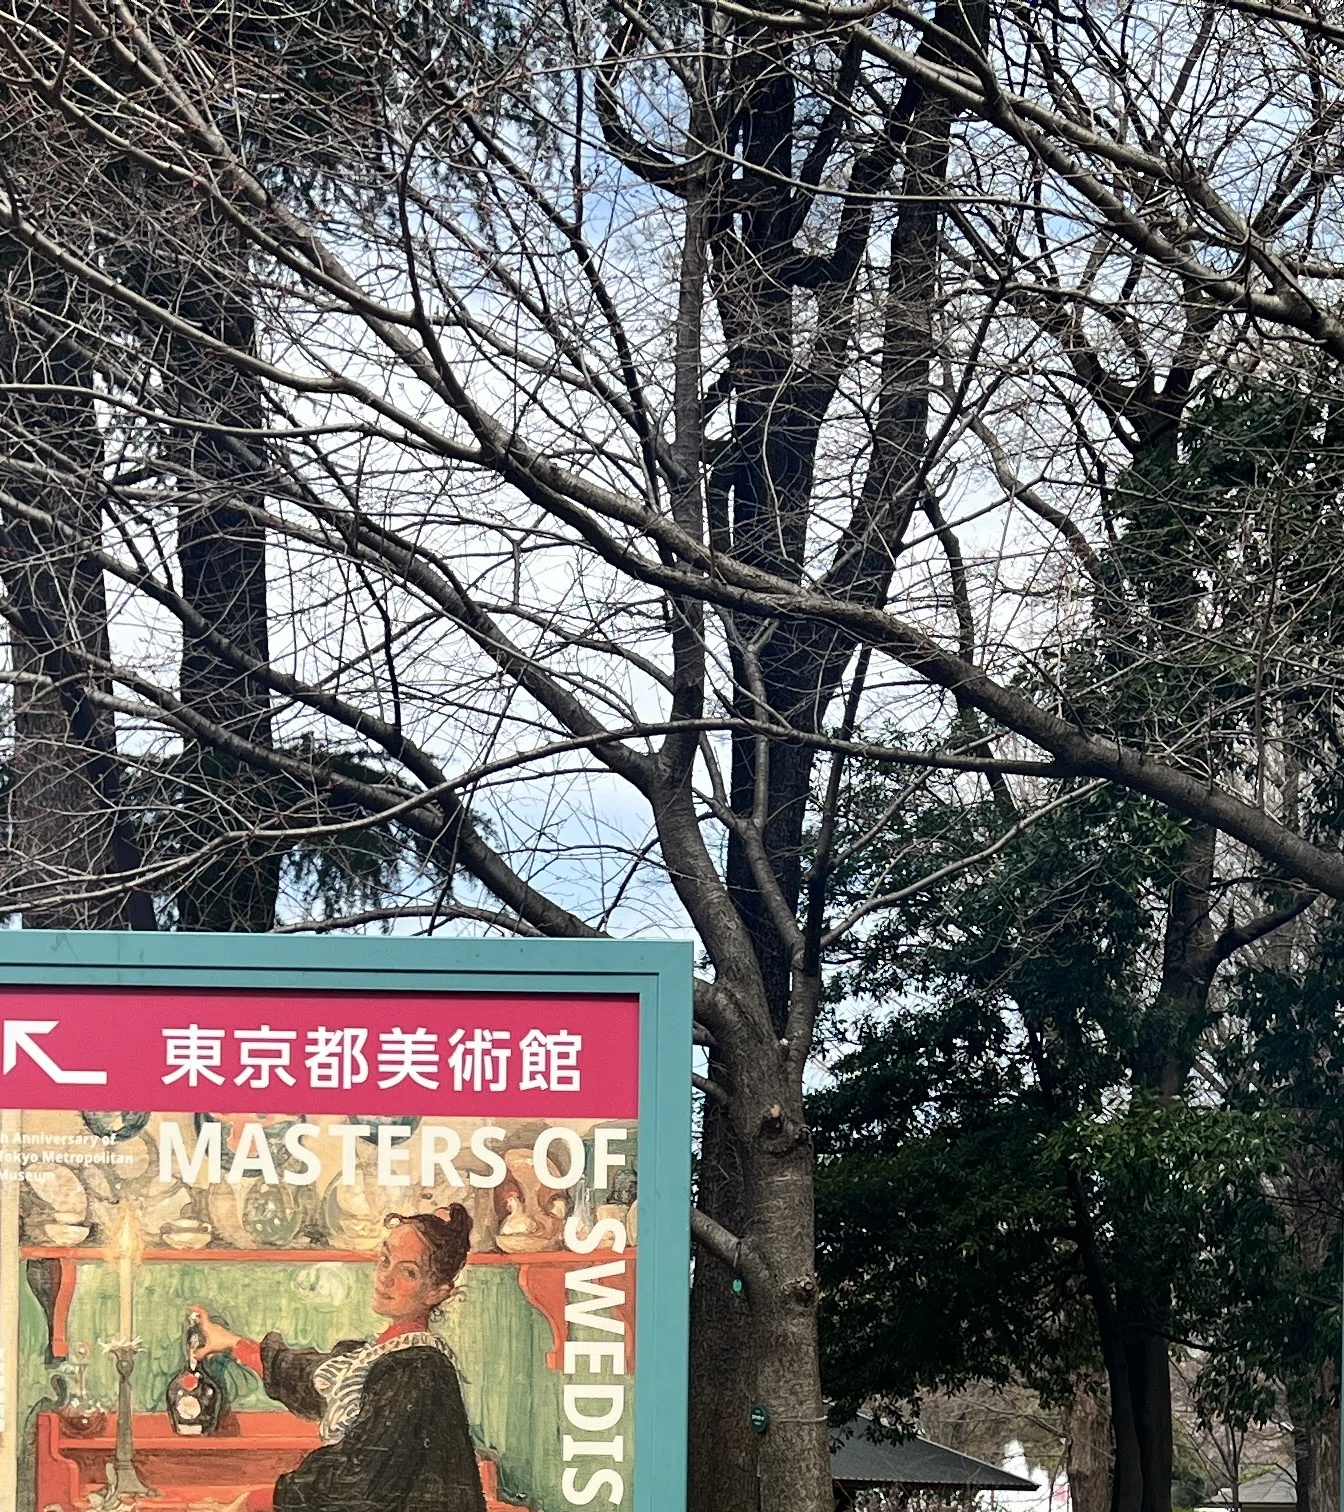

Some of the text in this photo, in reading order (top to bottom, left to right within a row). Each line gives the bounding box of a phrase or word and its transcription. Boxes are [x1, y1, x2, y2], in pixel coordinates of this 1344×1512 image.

[161, 1024, 584, 1093] 東京都美術館
[12, 1132, 98, 1149] Anniversary
[101, 1133, 117, 1146] of
[42, 1151, 134, 1167] Metropolitan
[157, 1122, 628, 1190] MASTERS OF
